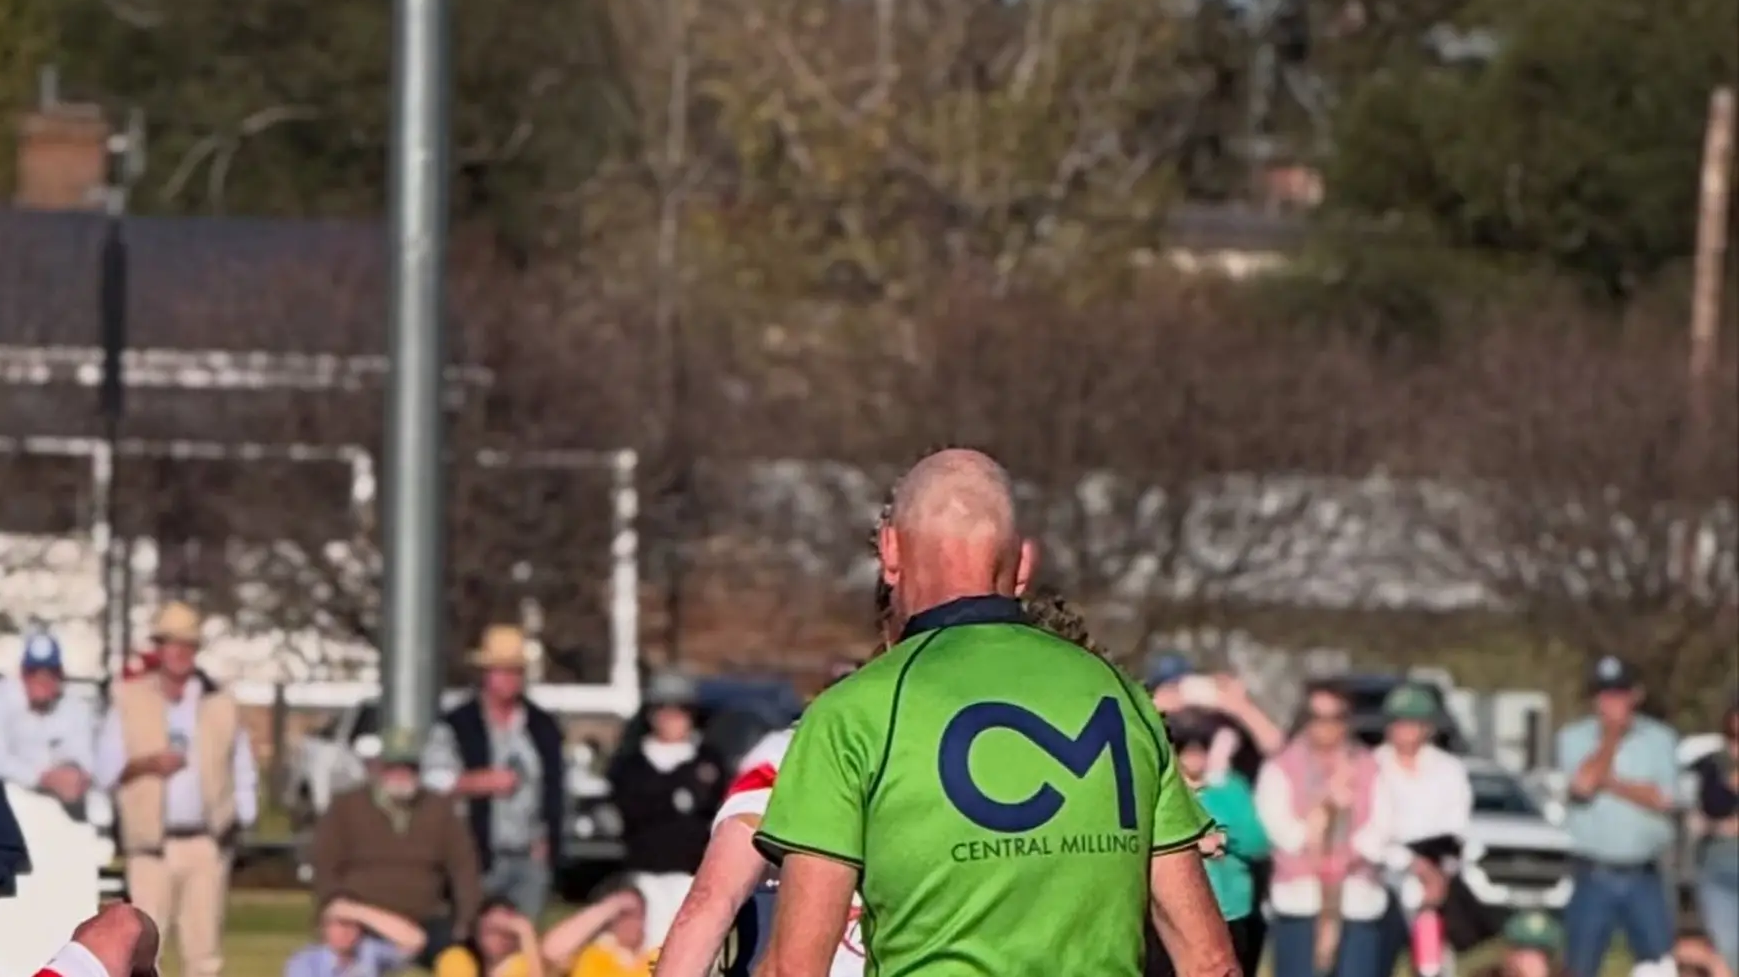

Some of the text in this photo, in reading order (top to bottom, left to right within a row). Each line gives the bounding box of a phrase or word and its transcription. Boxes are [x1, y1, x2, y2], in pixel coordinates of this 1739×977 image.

[938, 695, 1138, 834] CM
[950, 833, 1141, 864] CENTRAL MILLING
